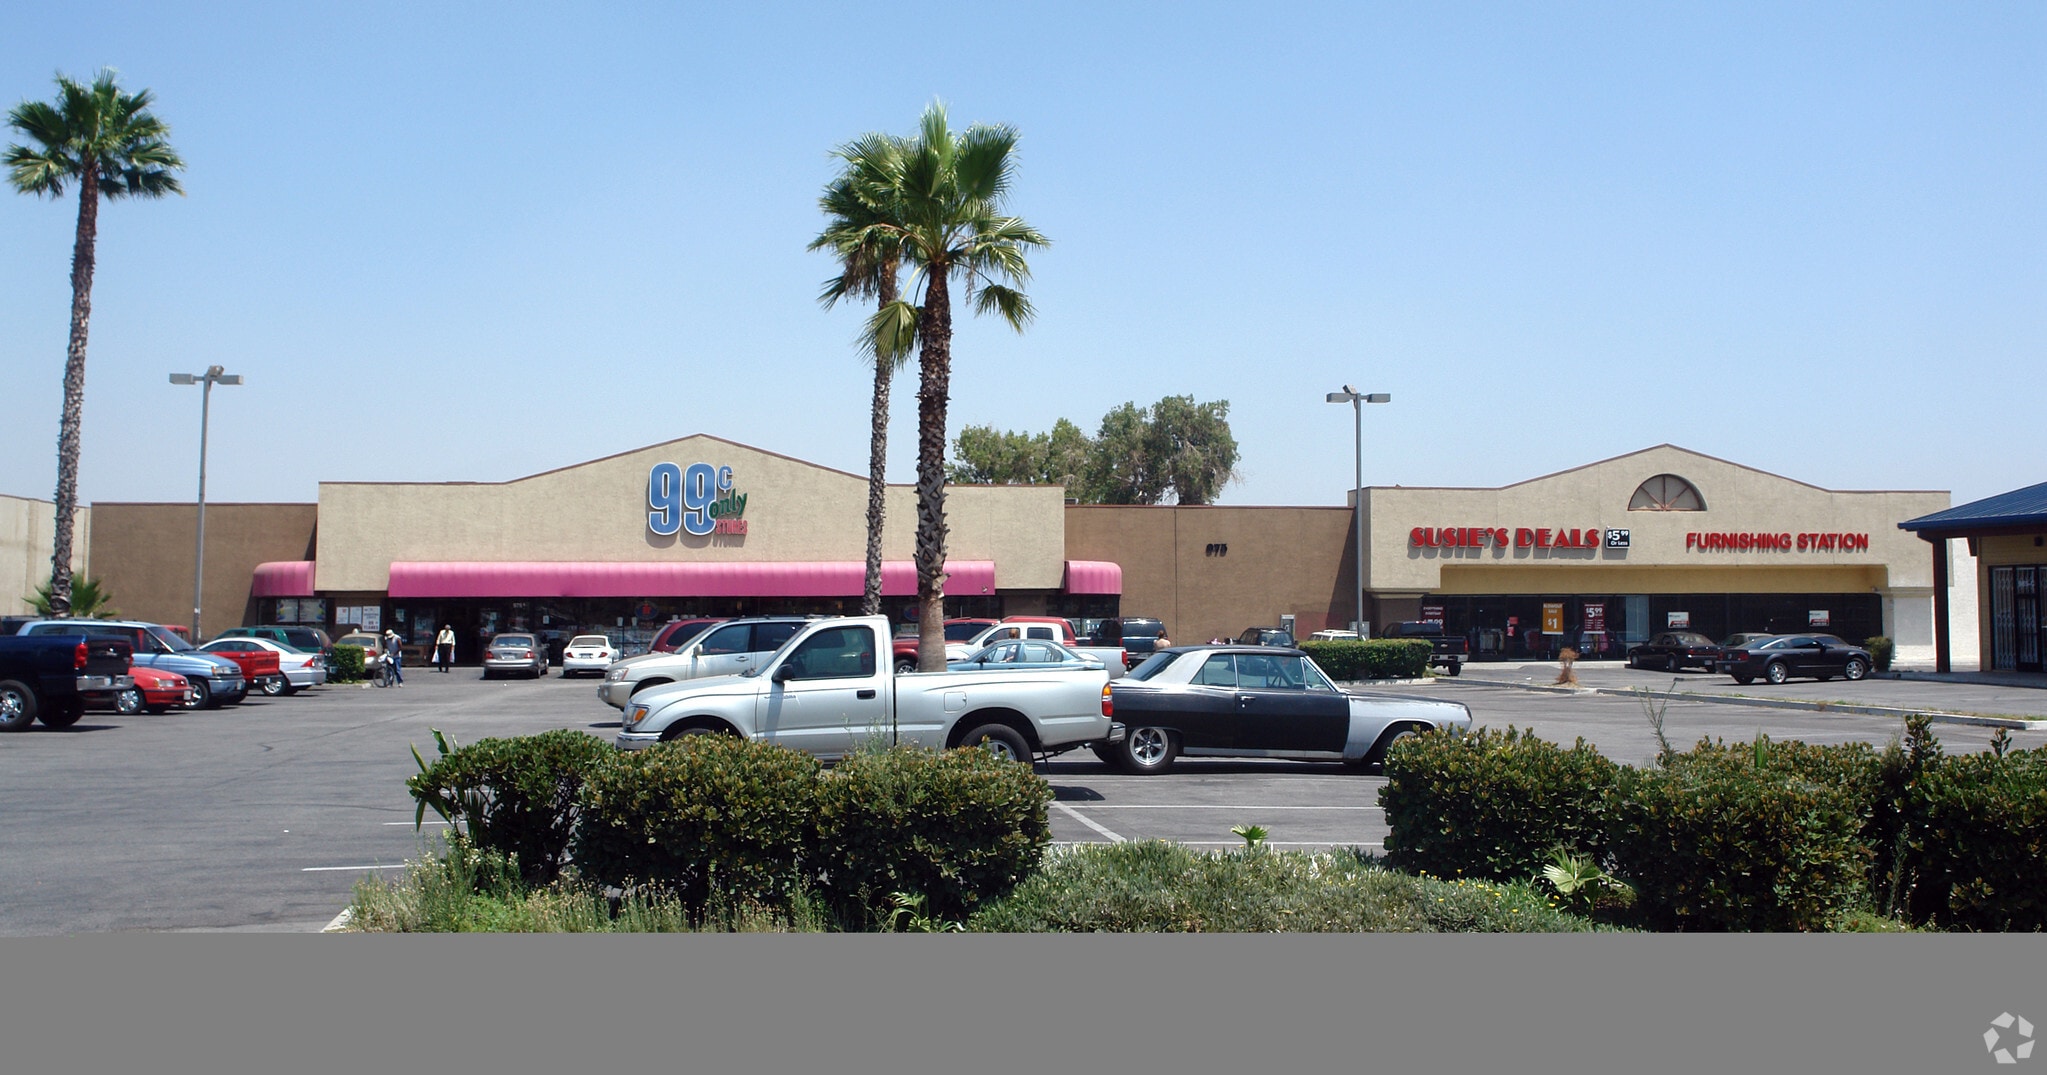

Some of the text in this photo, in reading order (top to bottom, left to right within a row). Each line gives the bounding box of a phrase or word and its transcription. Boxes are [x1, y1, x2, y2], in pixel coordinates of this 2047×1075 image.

[708, 488, 748, 519] only
[715, 519, 748, 535] STORES
[1410, 527, 1600, 548] SUSIE'S DEALS
[1686, 532, 1869, 549] FURNISHING STATION
[1547, 618, 1558, 629] $1
